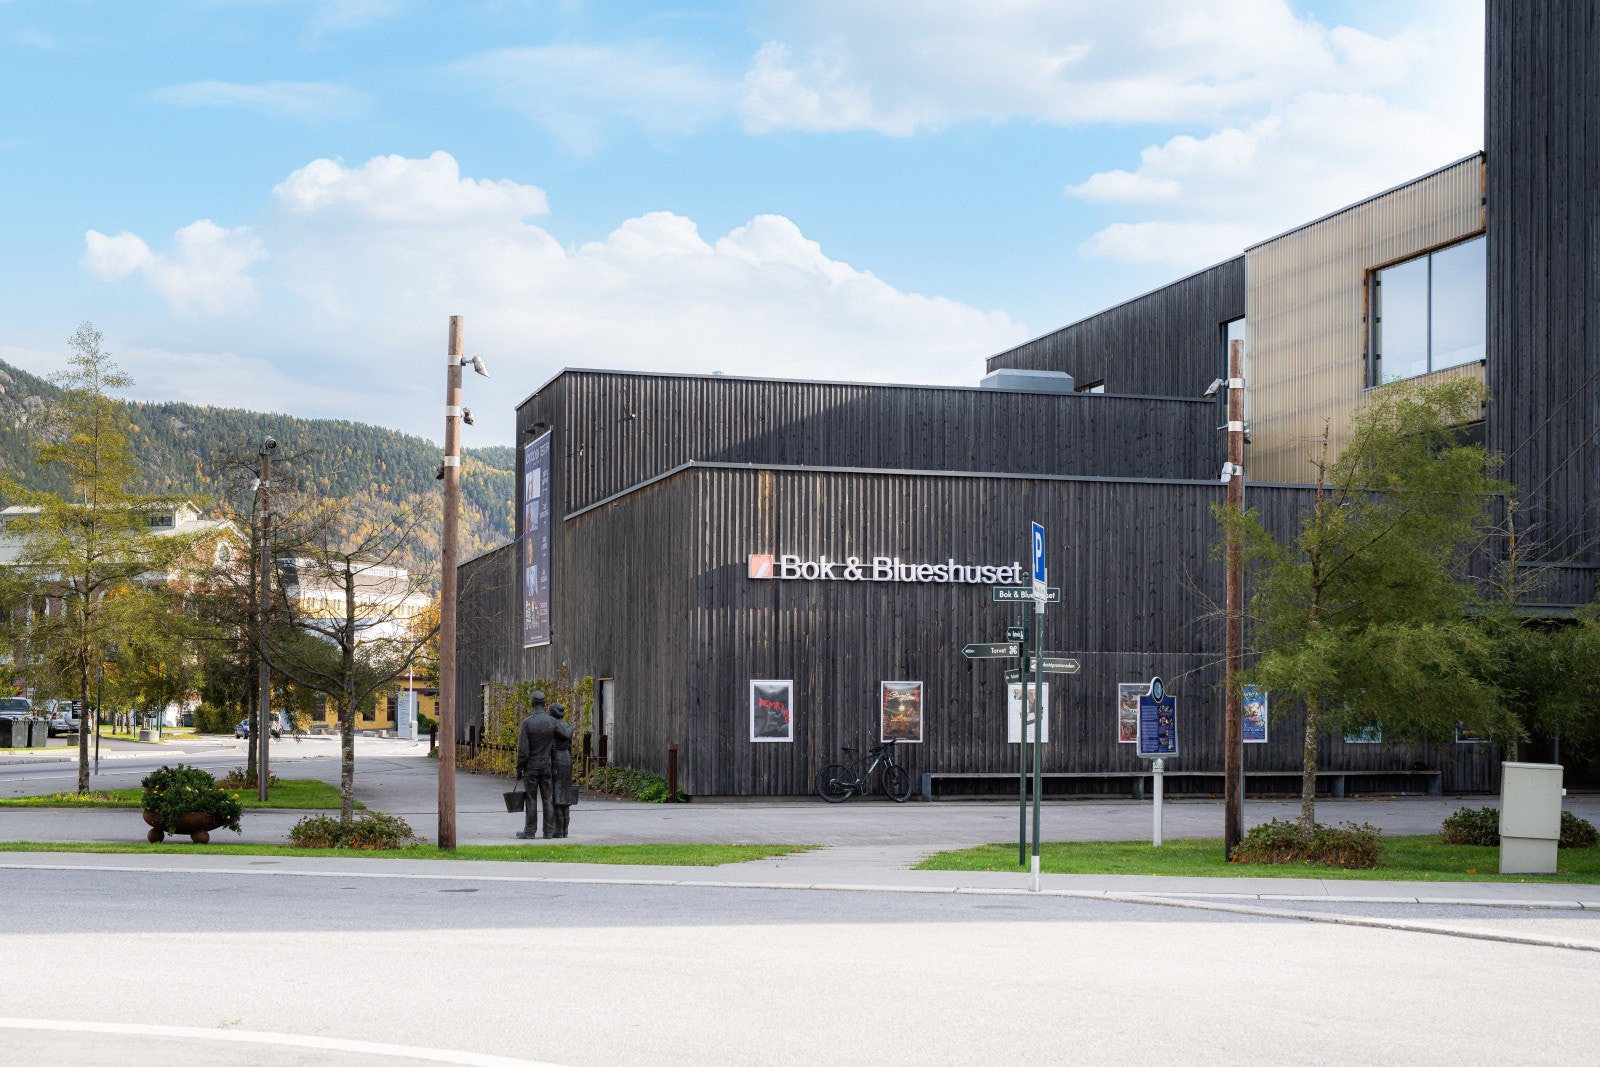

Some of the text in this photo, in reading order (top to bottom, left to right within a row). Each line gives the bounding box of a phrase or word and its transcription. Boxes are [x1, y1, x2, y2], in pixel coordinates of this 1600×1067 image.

[1035, 531, 1042, 573] P
[780, 554, 1022, 584] Bok & Blueshuset
[999, 590, 1012, 598] Bok
[1013, 590, 1019, 598] &
